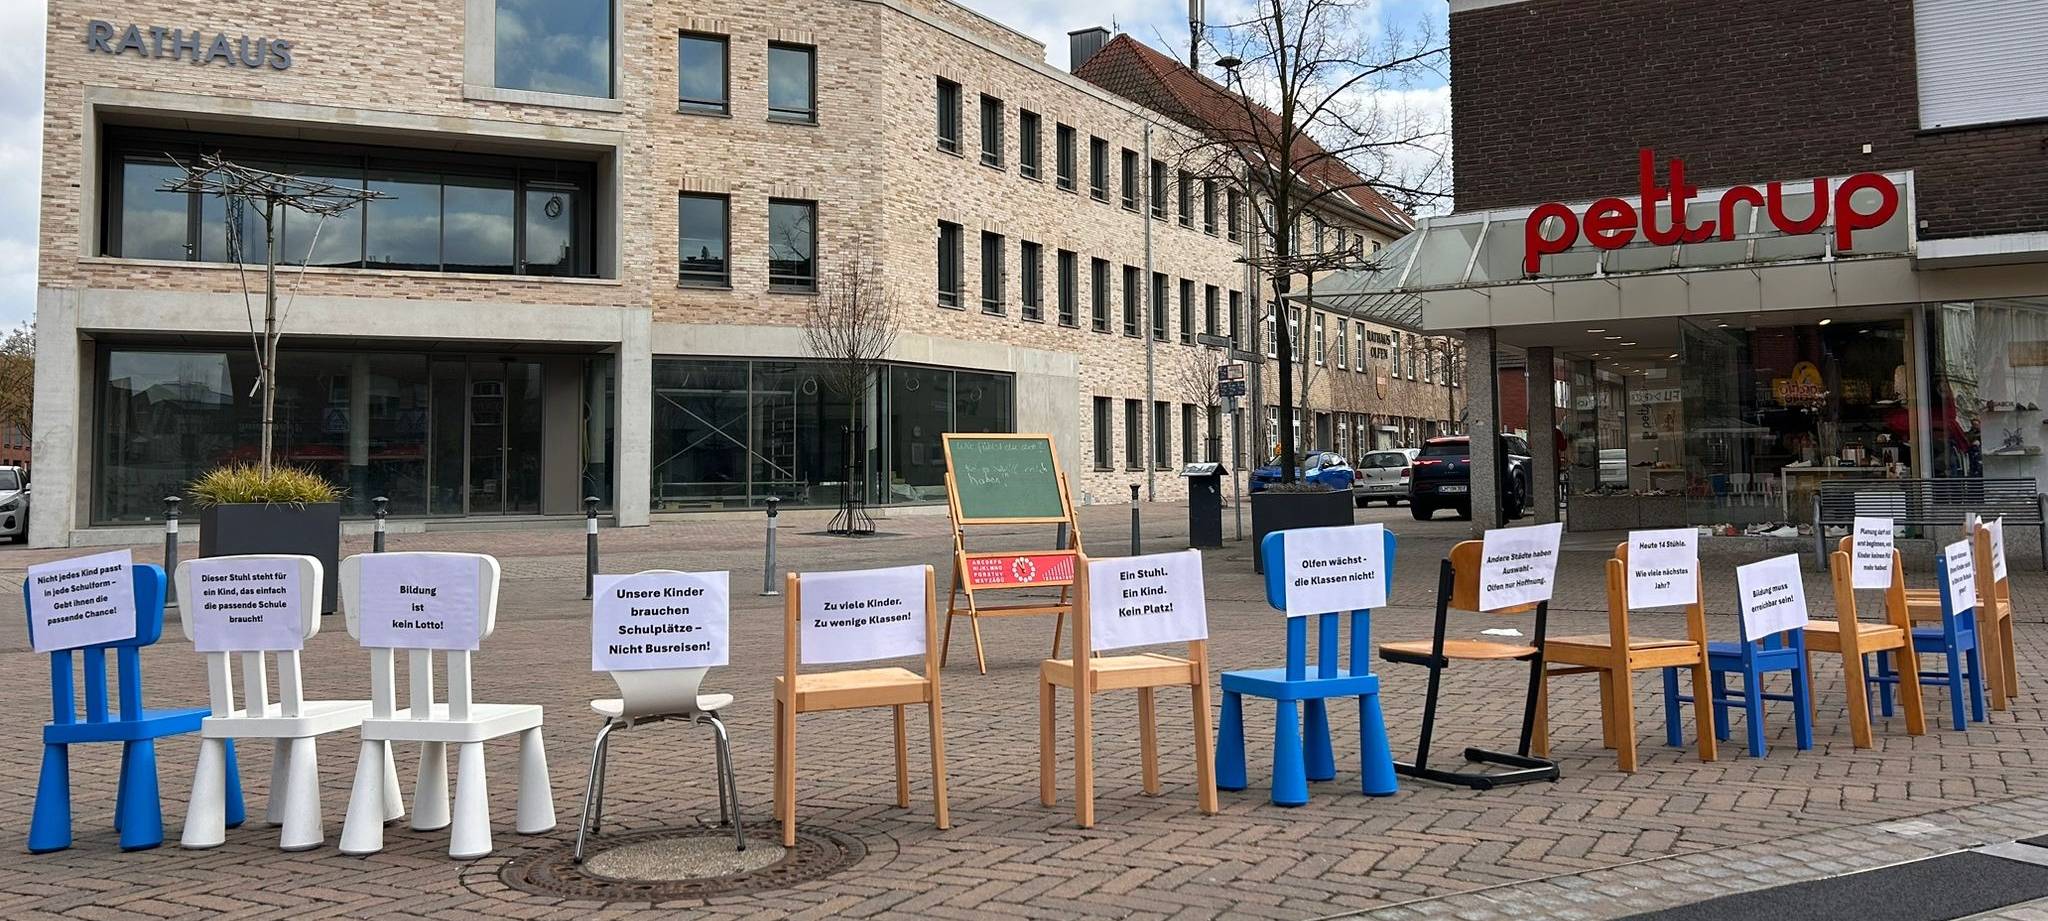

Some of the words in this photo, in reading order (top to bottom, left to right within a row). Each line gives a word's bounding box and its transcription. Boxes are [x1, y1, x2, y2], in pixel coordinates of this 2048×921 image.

[88, 19, 292, 70] RATHAUS
[1525, 149, 1899, 273] pettrup
[1366, 330, 1390, 345] RATHAUS
[1370, 346, 1388, 359] OLFEN
[1511, 552, 1532, 560] Städte
[1532, 550, 1552, 558] haben
[1302, 559, 1327, 568] Olfen
[1329, 556, 1362, 566] wächst
[37, 575, 58, 584] Nicht
[59, 572, 80, 582] jedes
[81, 568, 98, 577] Kind
[100, 564, 122, 574] passt
[1120, 572, 1135, 580] Ein
[1137, 567, 1168, 578] Stuhl.
[1502, 565, 1529, 575] Auswahl
[1662, 568, 1688, 576] nächstes
[1295, 578, 1309, 586] die
[1311, 575, 1347, 585] Klassen
[1349, 570, 1375, 581] nicht!
[52, 586, 69, 597] jede
[70, 580, 110, 592] Schulform
[400, 586, 437, 596] Bildung
[1123, 589, 1138, 598] Ein
[1140, 585, 1167, 596] Kind.
[1486, 583, 1504, 592] Olfen
[1516, 578, 1546, 588] Hoffnung.
[1753, 587, 1772, 597] Bildung
[1772, 584, 1788, 592] muss
[218, 588, 238, 596] Kind,
[617, 589, 660, 599] Unsere
[664, 587, 704, 597] Kinder
[54, 601, 72, 610] Gebt
[73, 598, 94, 606] ihnen
[96, 595, 108, 603] die
[218, 601, 257, 611] passende
[412, 603, 424, 611] ist
[824, 602, 837, 610] Zu
[840, 601, 865, 610] viele
[867, 598, 902, 608] Kinder.
[1752, 599, 1777, 612] erreichbar
[1778, 595, 1794, 604] sein!
[47, 613, 83, 626] passende
[85, 607, 117, 618] Chance!
[631, 606, 689, 616] brauchen
[1119, 607, 1141, 617] Kein
[1144, 603, 1173, 614] Platz!
[392, 620, 413, 628] kein
[415, 620, 444, 629] Lotto!
[814, 619, 828, 627] Zu
[830, 618, 866, 627] wenige
[869, 612, 911, 624] Klassen!
[618, 624, 692, 636] Schulplätze
[609, 644, 642, 654] Nicht
[645, 642, 710, 653] Busreisen!
